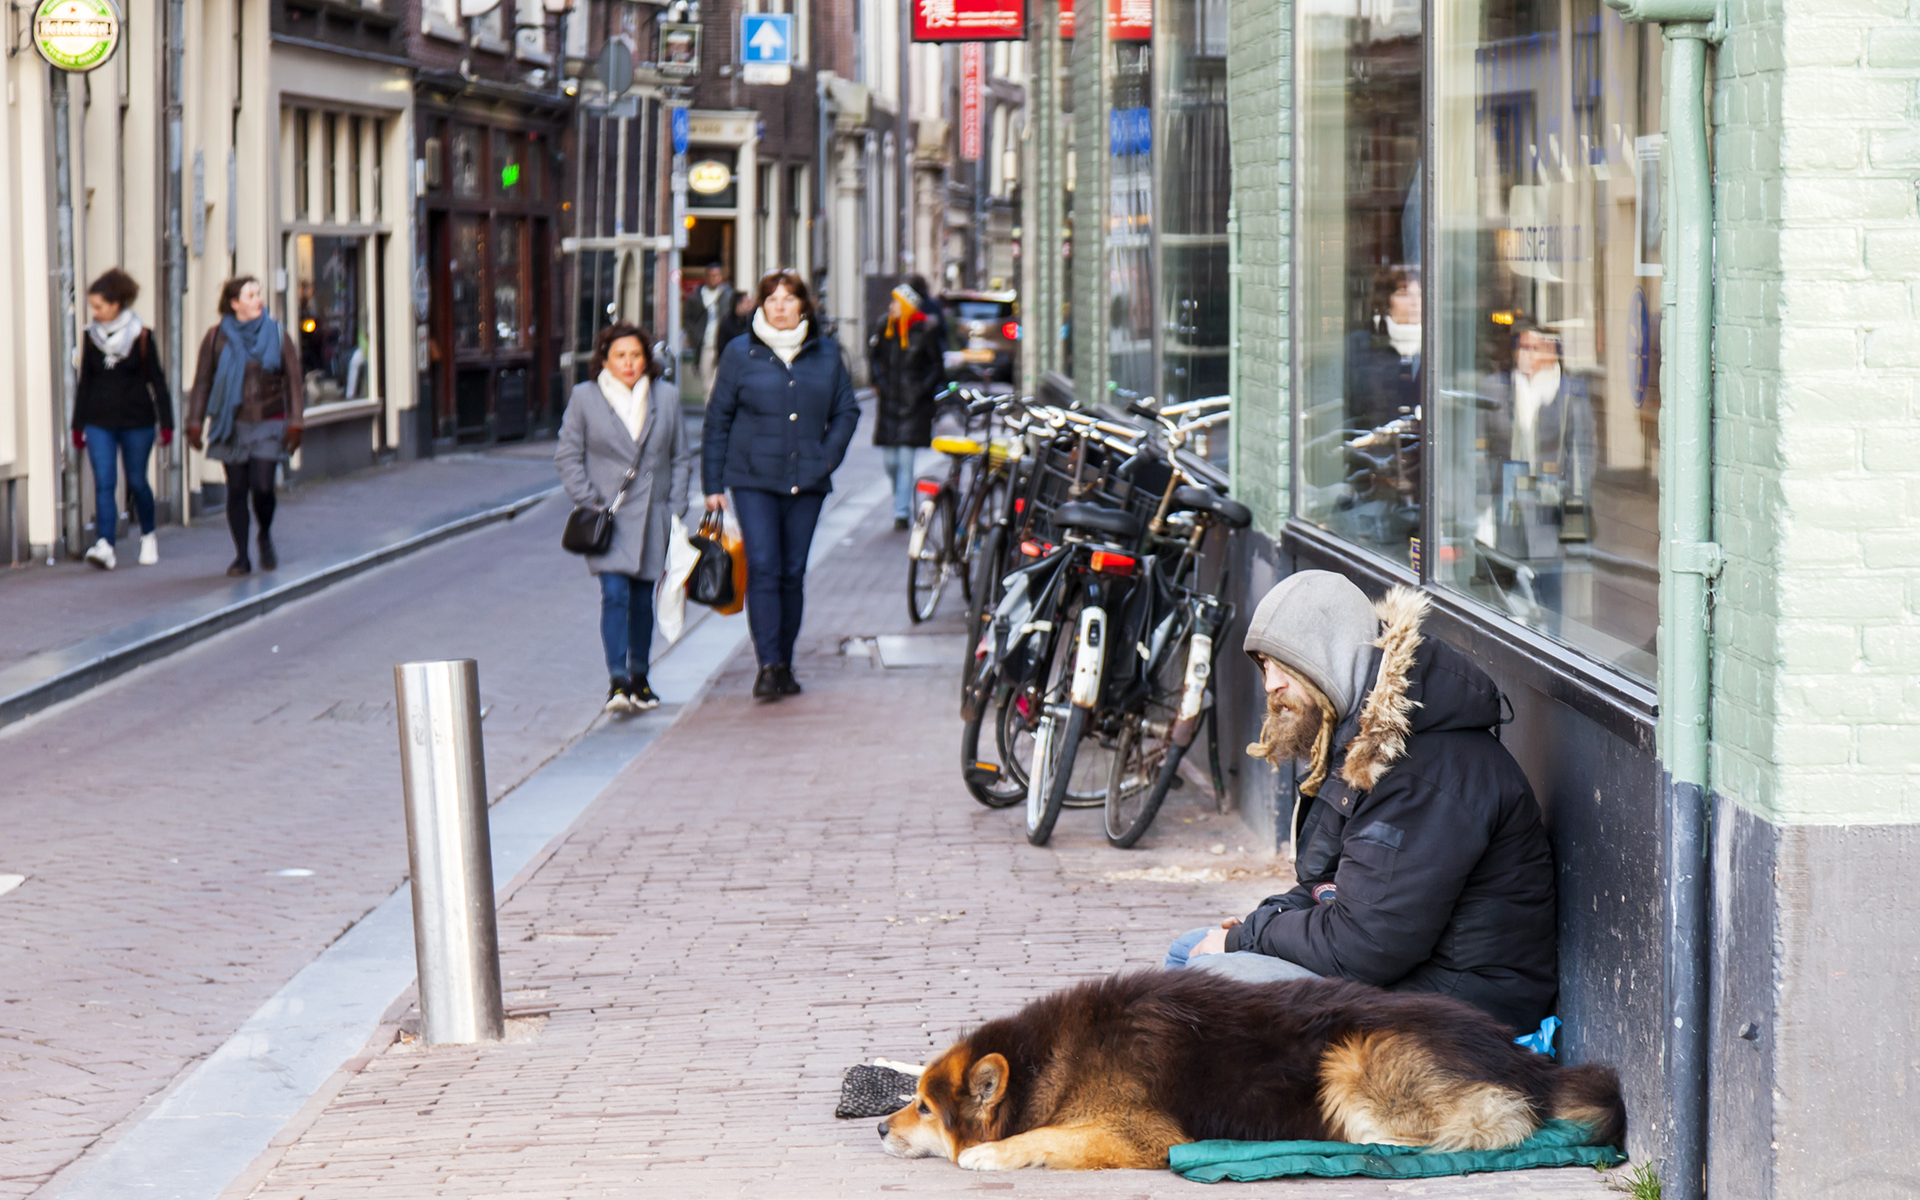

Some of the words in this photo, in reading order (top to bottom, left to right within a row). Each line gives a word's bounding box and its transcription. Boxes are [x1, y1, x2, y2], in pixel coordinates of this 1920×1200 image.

[40, 20, 108, 36] Heineken
[1475, 9, 1625, 178] PANCAKES
[1504, 213, 1583, 262] Amsterdam
